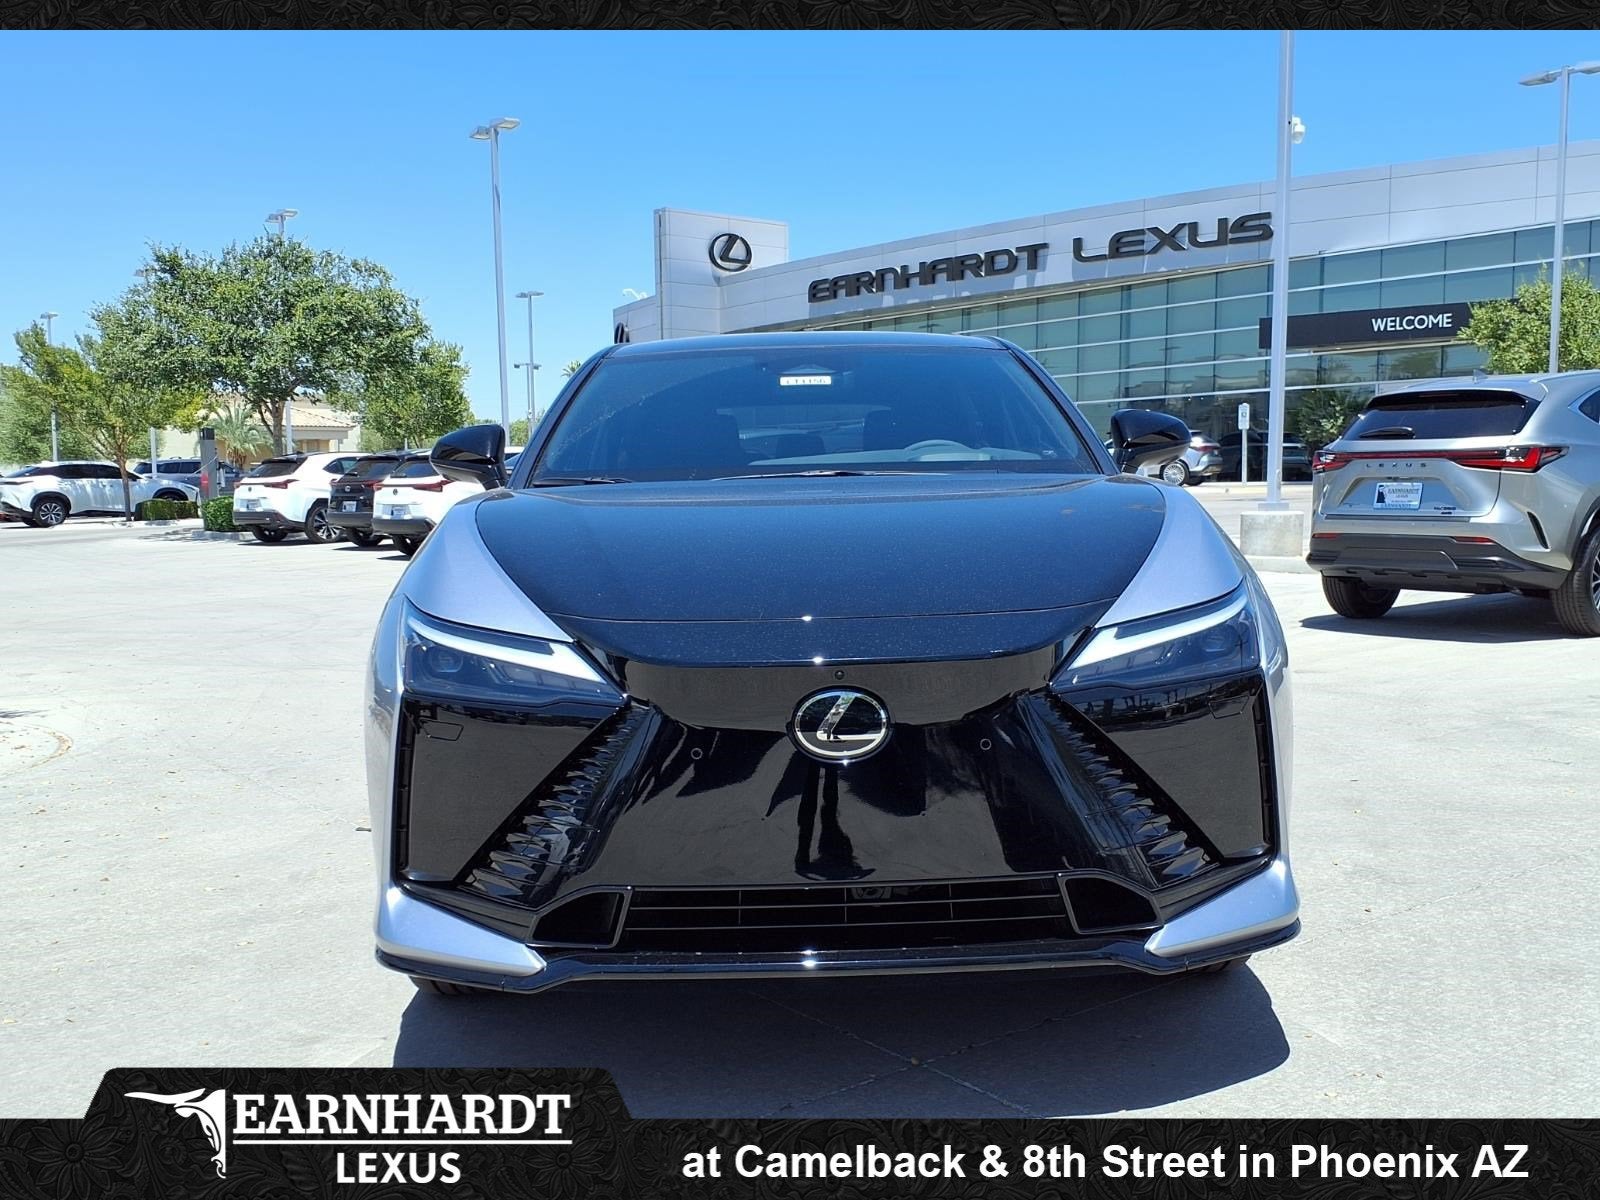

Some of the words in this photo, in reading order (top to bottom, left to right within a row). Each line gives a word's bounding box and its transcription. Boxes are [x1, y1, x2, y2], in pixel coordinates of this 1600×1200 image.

[808, 242, 1049, 303] EARNHARDT
[1072, 211, 1274, 262] LEXUS
[1371, 313, 1453, 332] WELCOME
